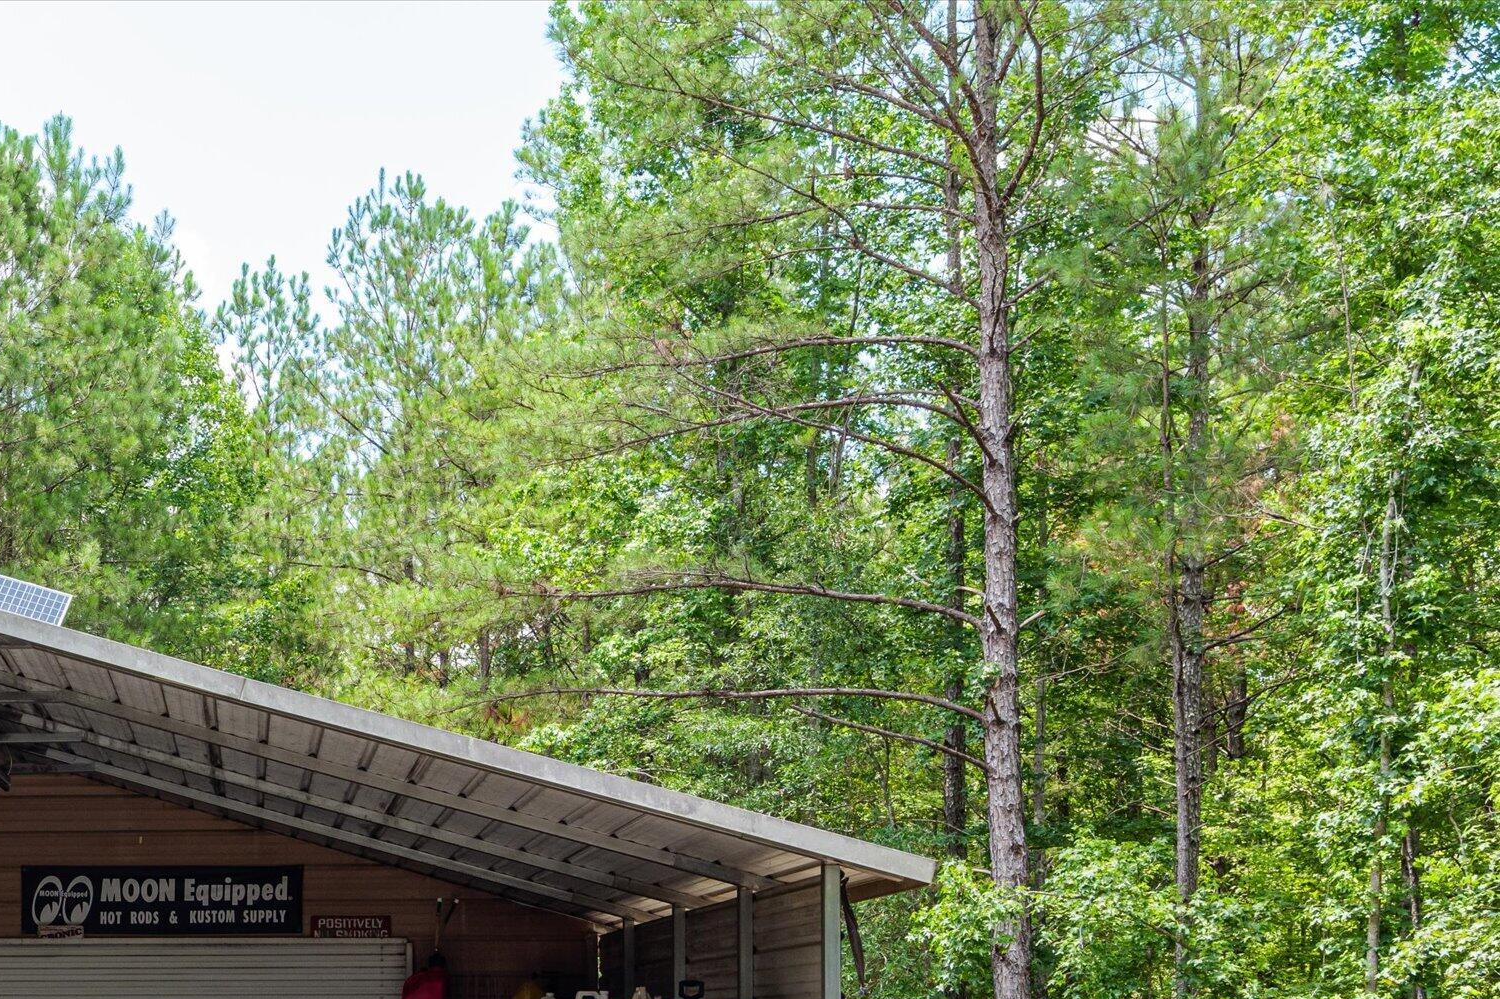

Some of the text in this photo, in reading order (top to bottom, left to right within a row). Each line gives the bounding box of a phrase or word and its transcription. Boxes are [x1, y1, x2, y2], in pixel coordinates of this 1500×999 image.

[39, 889, 88, 899] MOON Equipped
[100, 878, 176, 903] MOON
[100, 909, 287, 925] HOT RODS & KUSTOM SUPPLY
[318, 918, 384, 929] POSITIVELY
